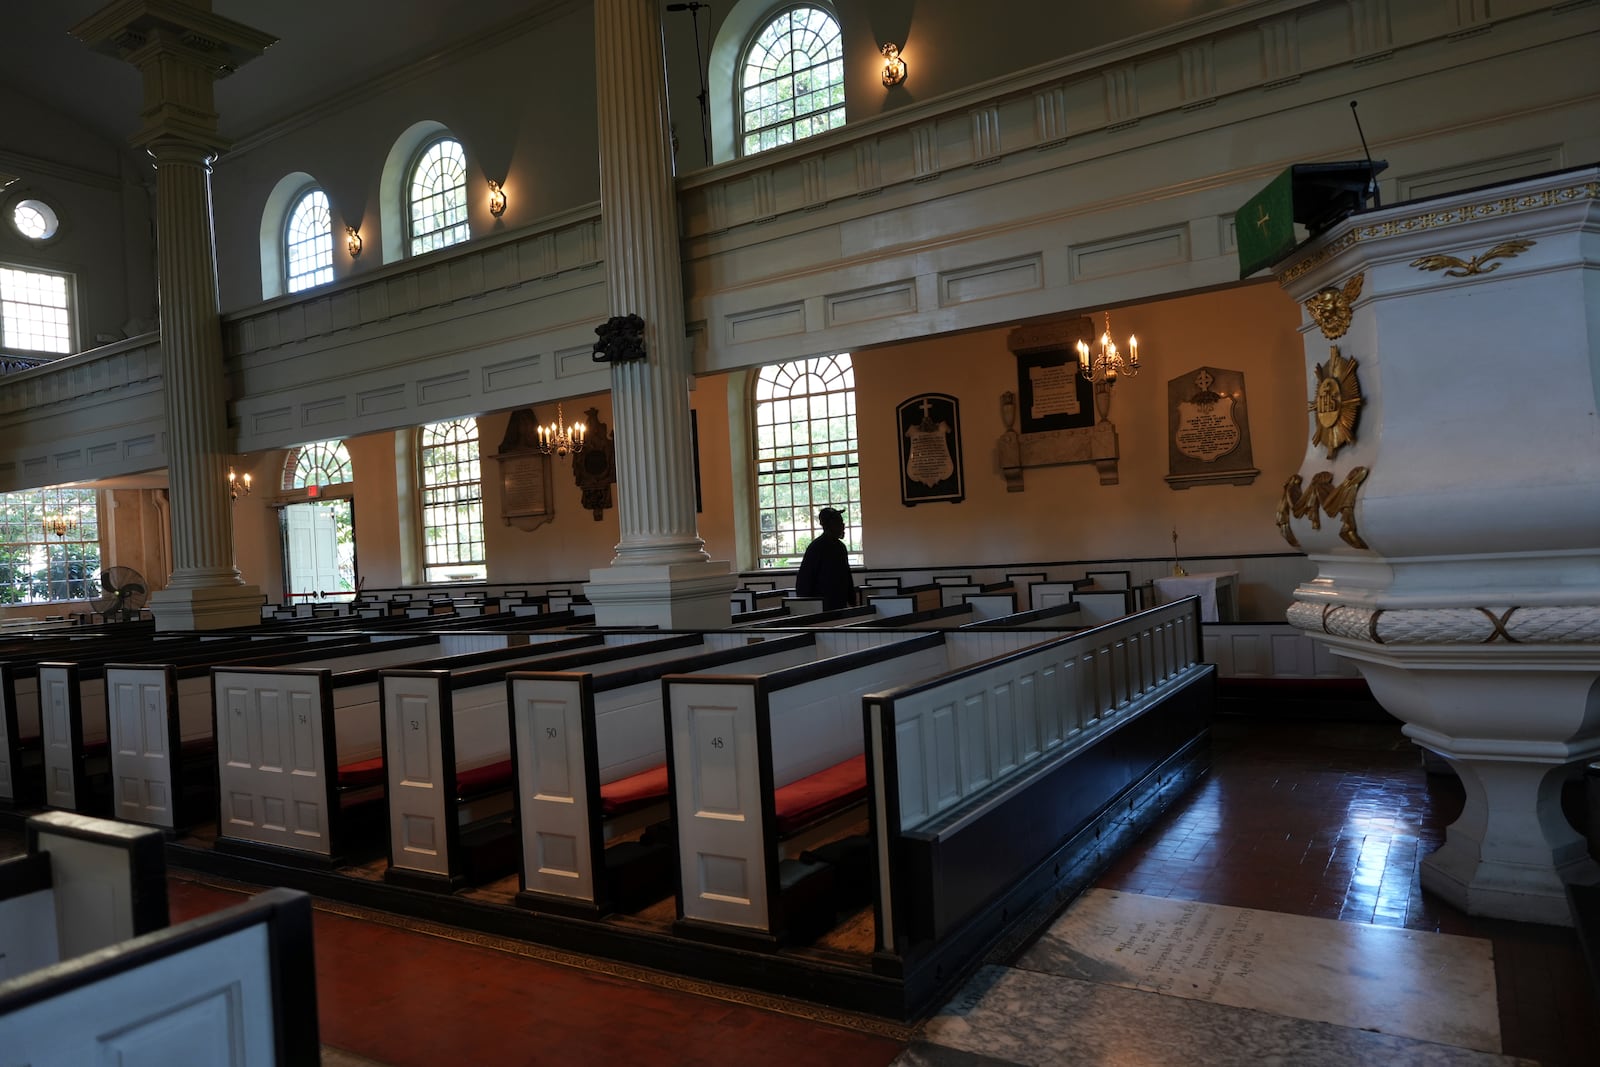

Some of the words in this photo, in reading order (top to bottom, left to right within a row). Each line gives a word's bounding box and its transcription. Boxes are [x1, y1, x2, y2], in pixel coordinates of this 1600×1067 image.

[410, 720, 419, 731] 52
[546, 727, 557, 739] 50
[711, 737, 724, 749] 48
